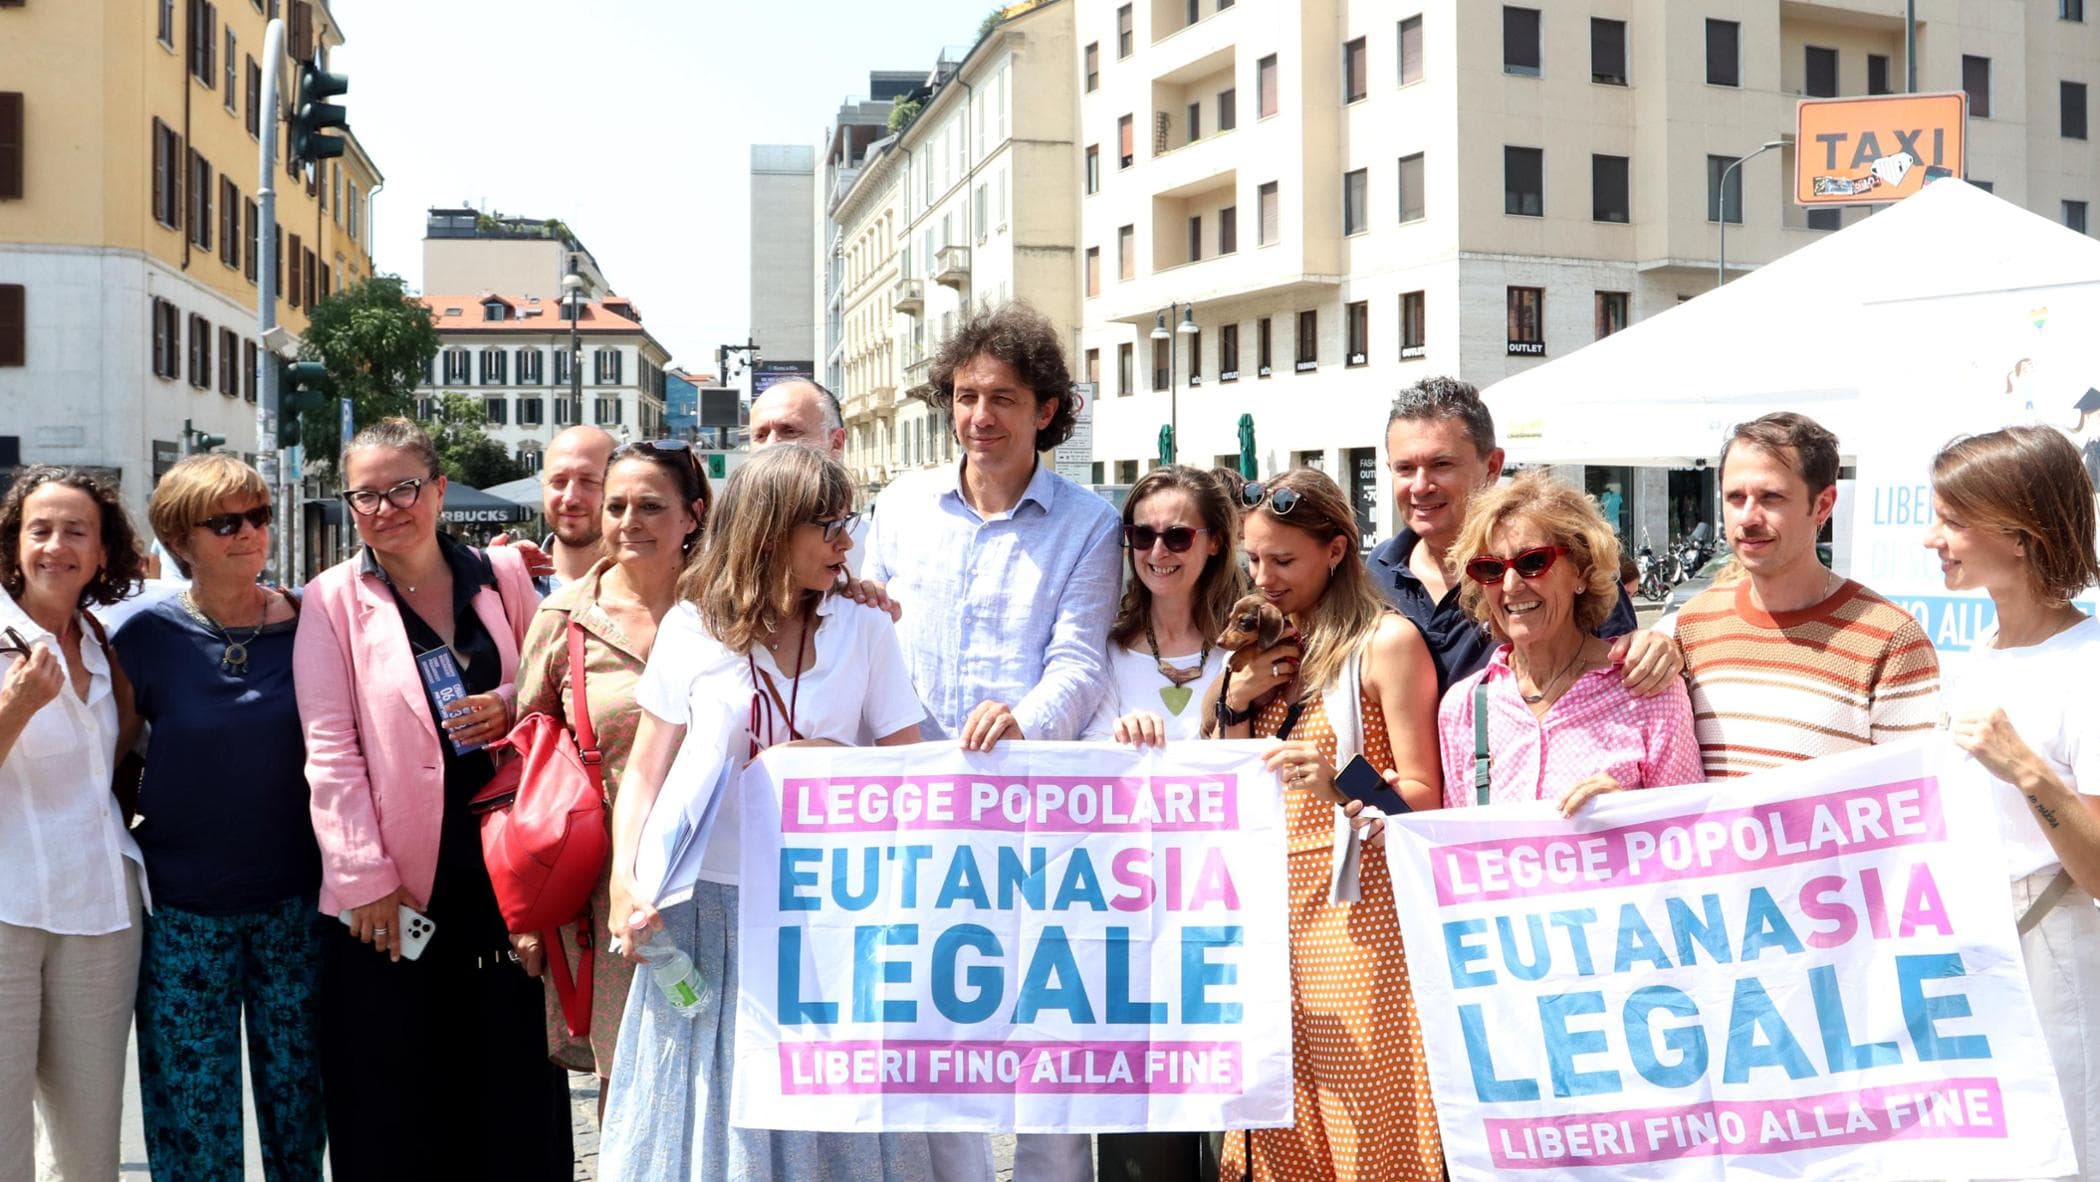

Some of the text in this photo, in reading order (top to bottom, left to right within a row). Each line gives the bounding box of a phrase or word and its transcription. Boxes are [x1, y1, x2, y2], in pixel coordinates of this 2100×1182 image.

[1816, 128, 1944, 171] TAXI
[1508, 343, 1544, 353] OUTLET
[1873, 485, 1933, 525] LIBE
[797, 783, 1226, 824] LEGGE POPOLARE
[1446, 788, 1927, 897] LEGGE POPOLARE
[778, 844, 1242, 912] EUTANASIA
[1442, 862, 1954, 990] EUTANASIA
[777, 923, 1244, 1026] LEGALE
[1457, 952, 1992, 1103] LEGALE
[790, 1049, 1233, 1085] LIBERI FINO ALLA FINE
[1501, 1088, 1993, 1161] LIBERI FINO ALLA FINE
